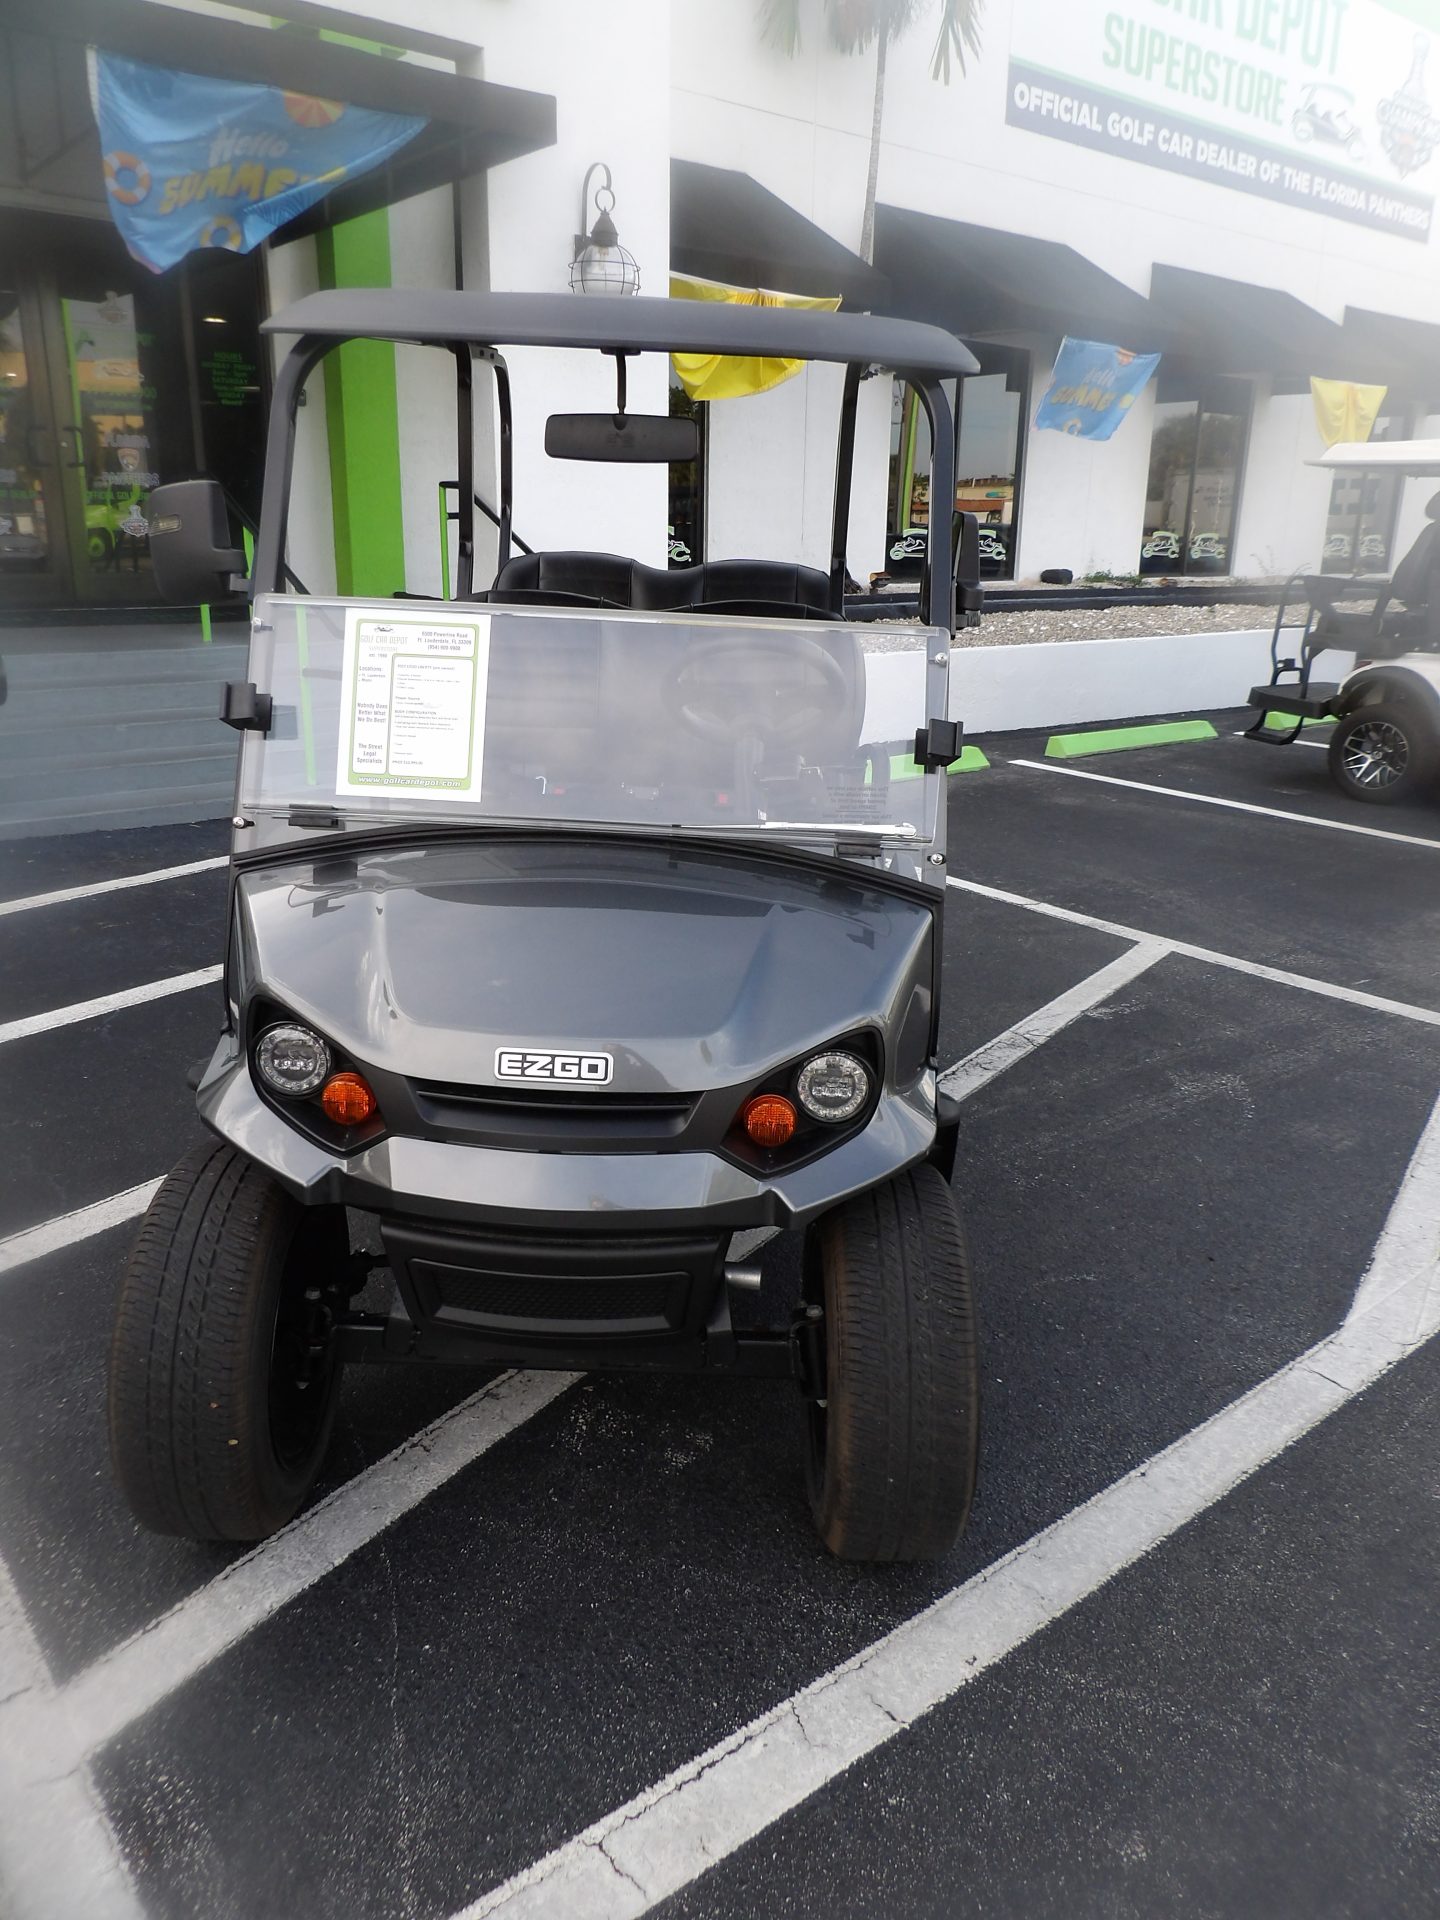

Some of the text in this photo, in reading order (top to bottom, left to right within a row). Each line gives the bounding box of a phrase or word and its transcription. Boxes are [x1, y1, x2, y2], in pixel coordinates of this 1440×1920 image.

[1102, 12, 1288, 127] SUPERSTORE
[1013, 82, 1431, 232] OFFICIAL GOLF CAR DEALER OF THE FLORIDA PANTHERS
[159, 161, 315, 215] SUMME
[363, 750, 377, 758] Legal
[500, 1053, 607, 1080] EZGO
